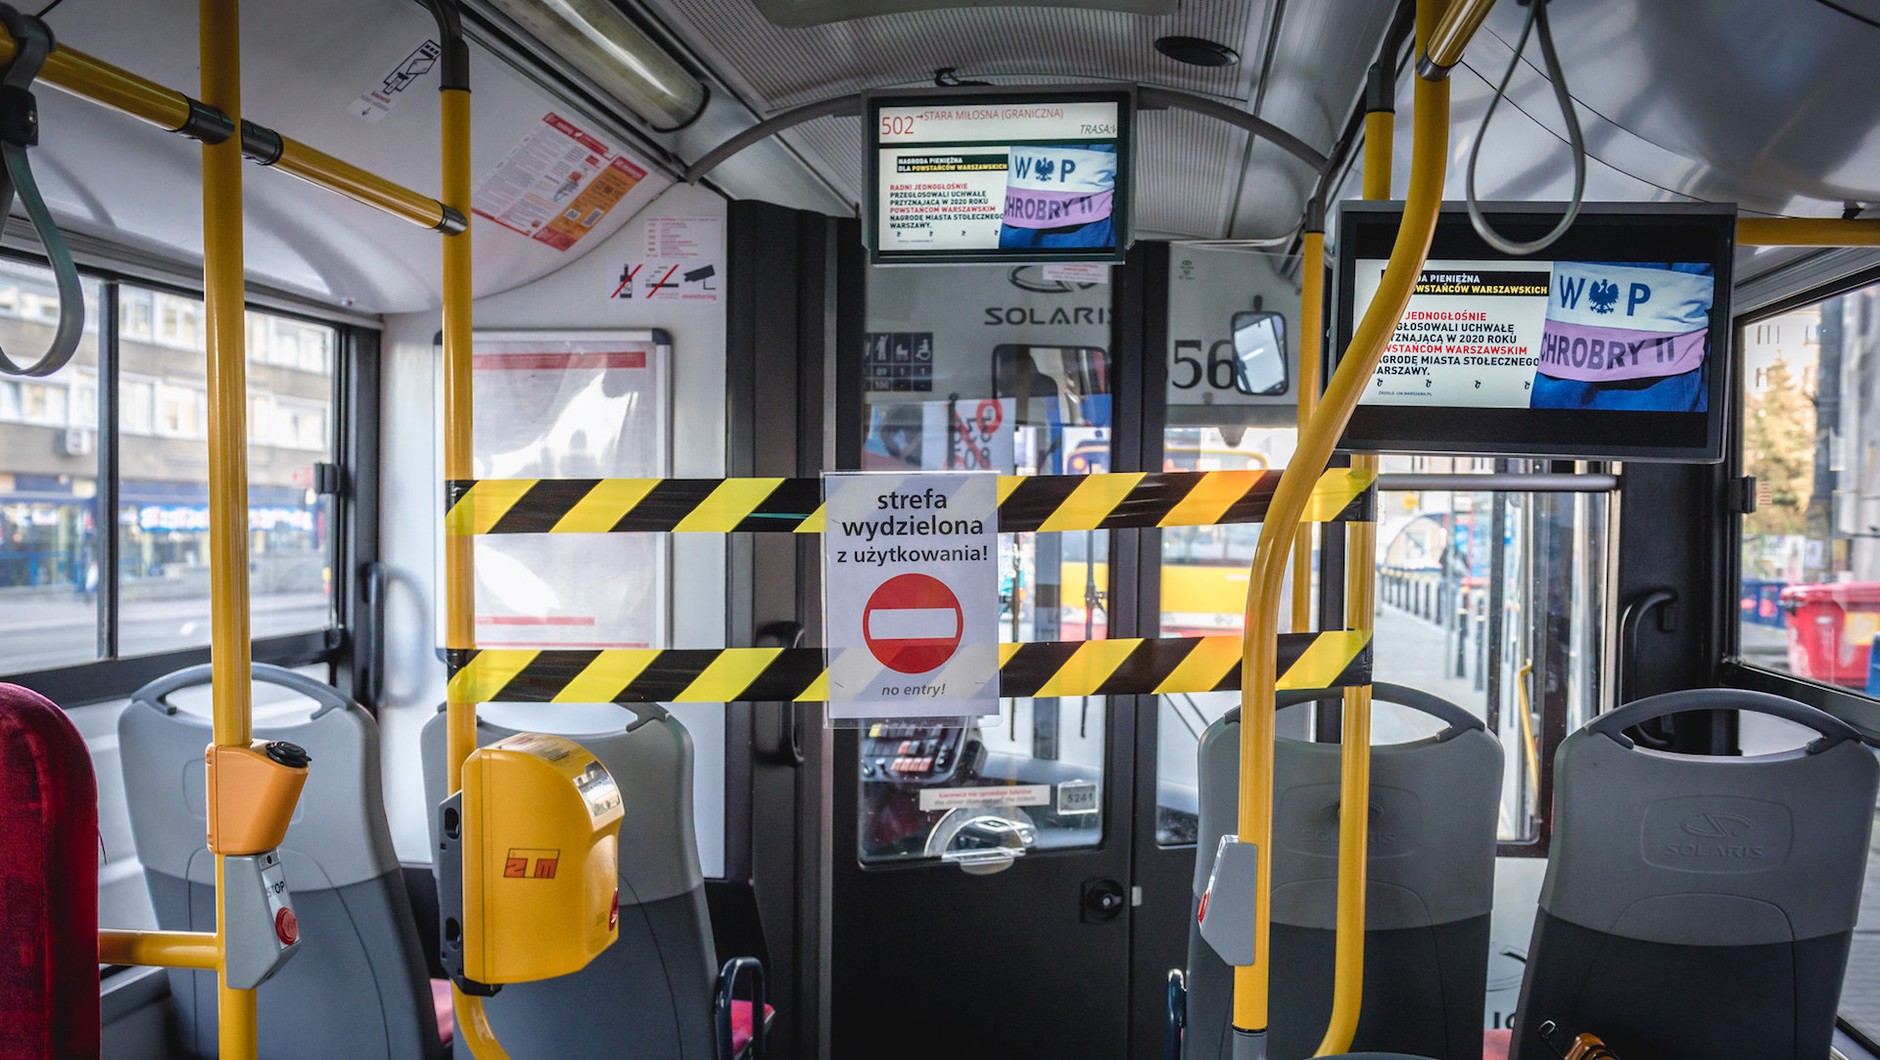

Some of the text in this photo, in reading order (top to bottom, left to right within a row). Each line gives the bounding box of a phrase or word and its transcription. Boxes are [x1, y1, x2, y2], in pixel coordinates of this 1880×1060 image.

[923, 108, 1064, 121] STARA MIŁOSNA (GRANICZNA)
[881, 116, 914, 135] 502
[956, 163, 1008, 171] WARSZAWSKICH
[1014, 156, 1076, 182] W P
[914, 182, 968, 190] JEDNOGŁOŚNIE
[951, 190, 987, 198] UCHWAŁĘ
[1430, 273, 1481, 285] PIENIĘŻNA
[1413, 283, 1548, 294] WSTAŃCÓW WARSZAWSKICH
[1560, 275, 1651, 317] W P
[984, 307, 1113, 325] SOLARI
[1405, 310, 1487, 321] JEDNOGŁOŚNIE
[1396, 323, 1514, 334] GŁOSOWALI UCHWAŁĘ
[1391, 333, 1517, 345] YZNAJĄCĄ W 2020 ROKU
[1445, 345, 1528, 355] WARSZAWSKIM
[1379, 355, 1540, 366] GRODĘ MIASTA STOŁECZNEGO
[1373, 366, 1431, 375] ARSZAWY.
[878, 489, 947, 509] strefa
[842, 515, 983, 541] wydzielona
[837, 545, 988, 566] z użytkowania!
[881, 683, 946, 697] no entry!
[1663, 843, 1764, 858] SOLARIS
[266, 881, 285, 898] STOP
